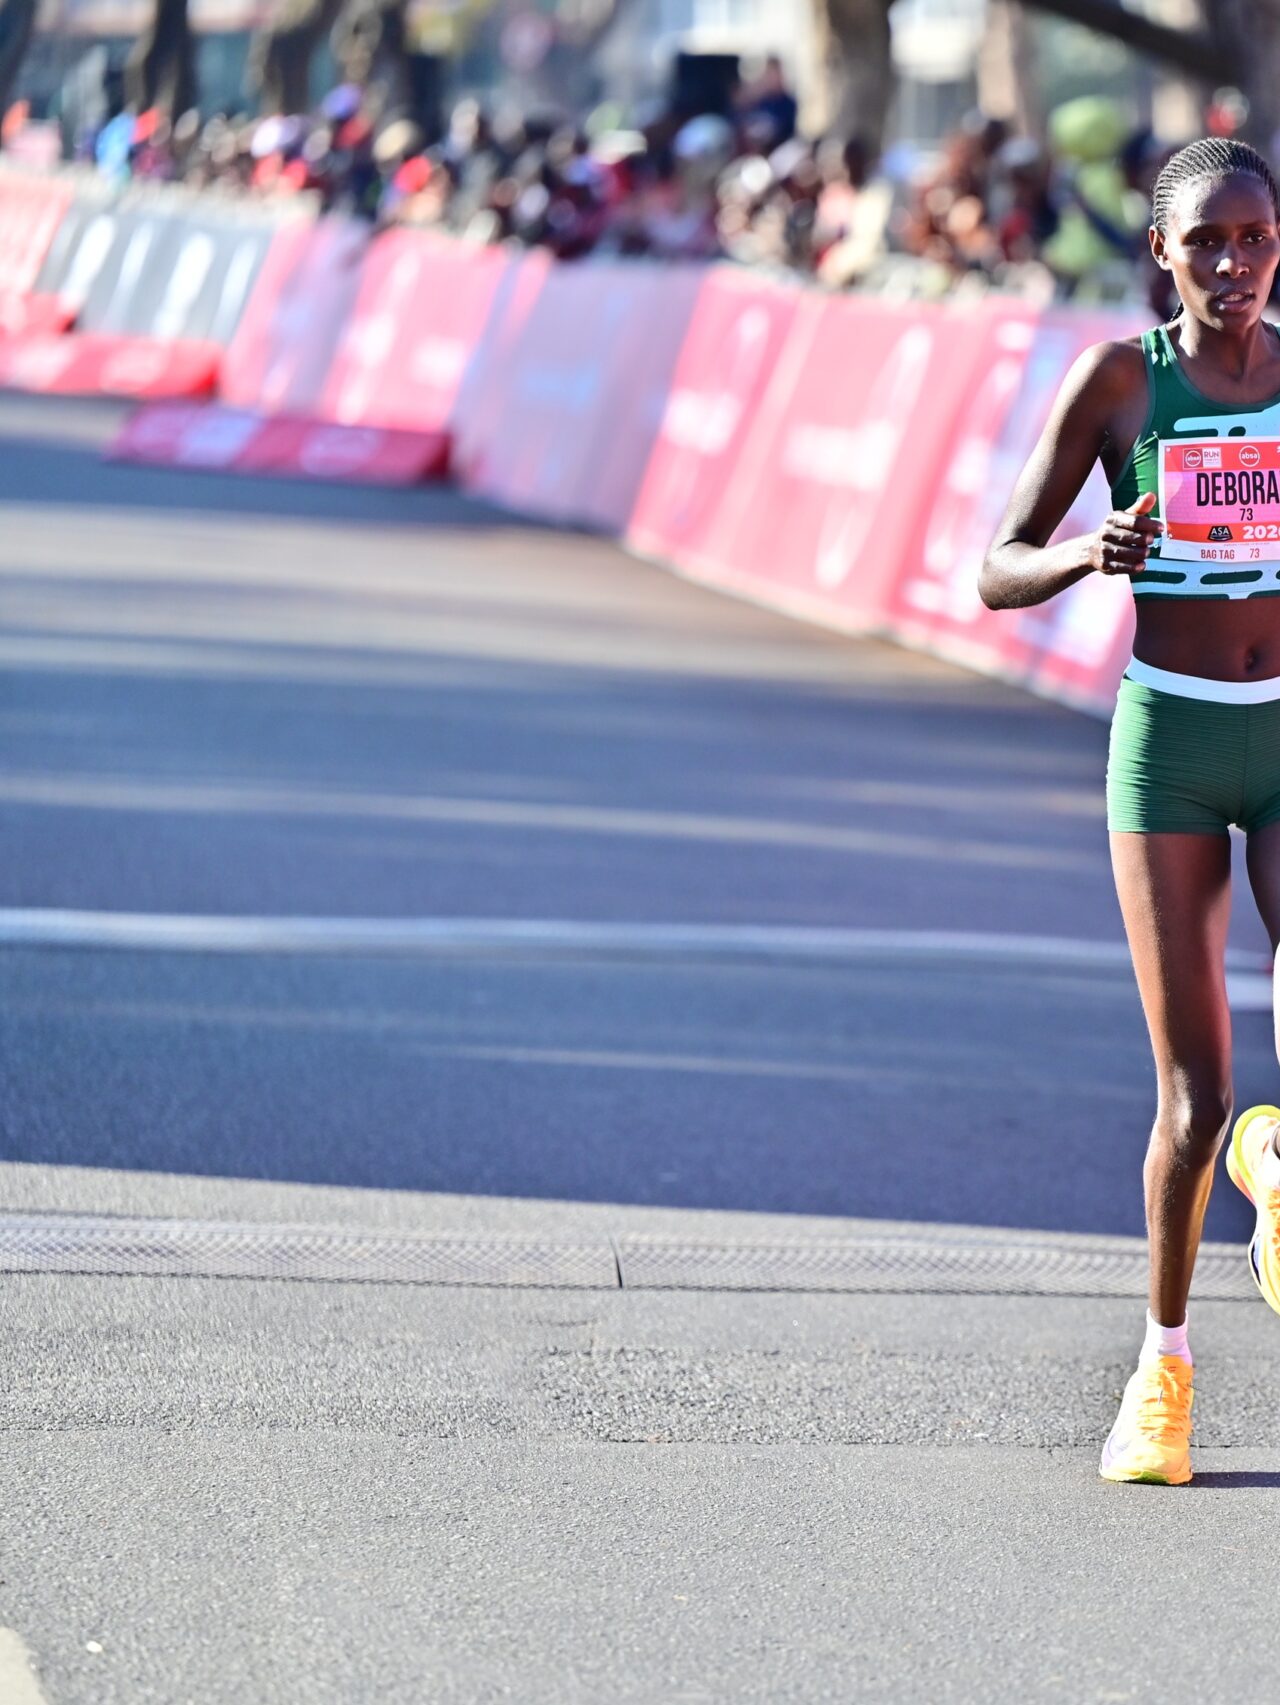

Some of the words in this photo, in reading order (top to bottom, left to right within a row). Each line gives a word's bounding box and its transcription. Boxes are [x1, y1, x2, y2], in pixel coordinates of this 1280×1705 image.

[1239, 508, 1254, 521] 73
[1210, 526, 1230, 536] ASA
[1200, 549, 1217, 559] BAG
[1219, 549, 1235, 560] TAG
[1249, 548, 1260, 558] 73
